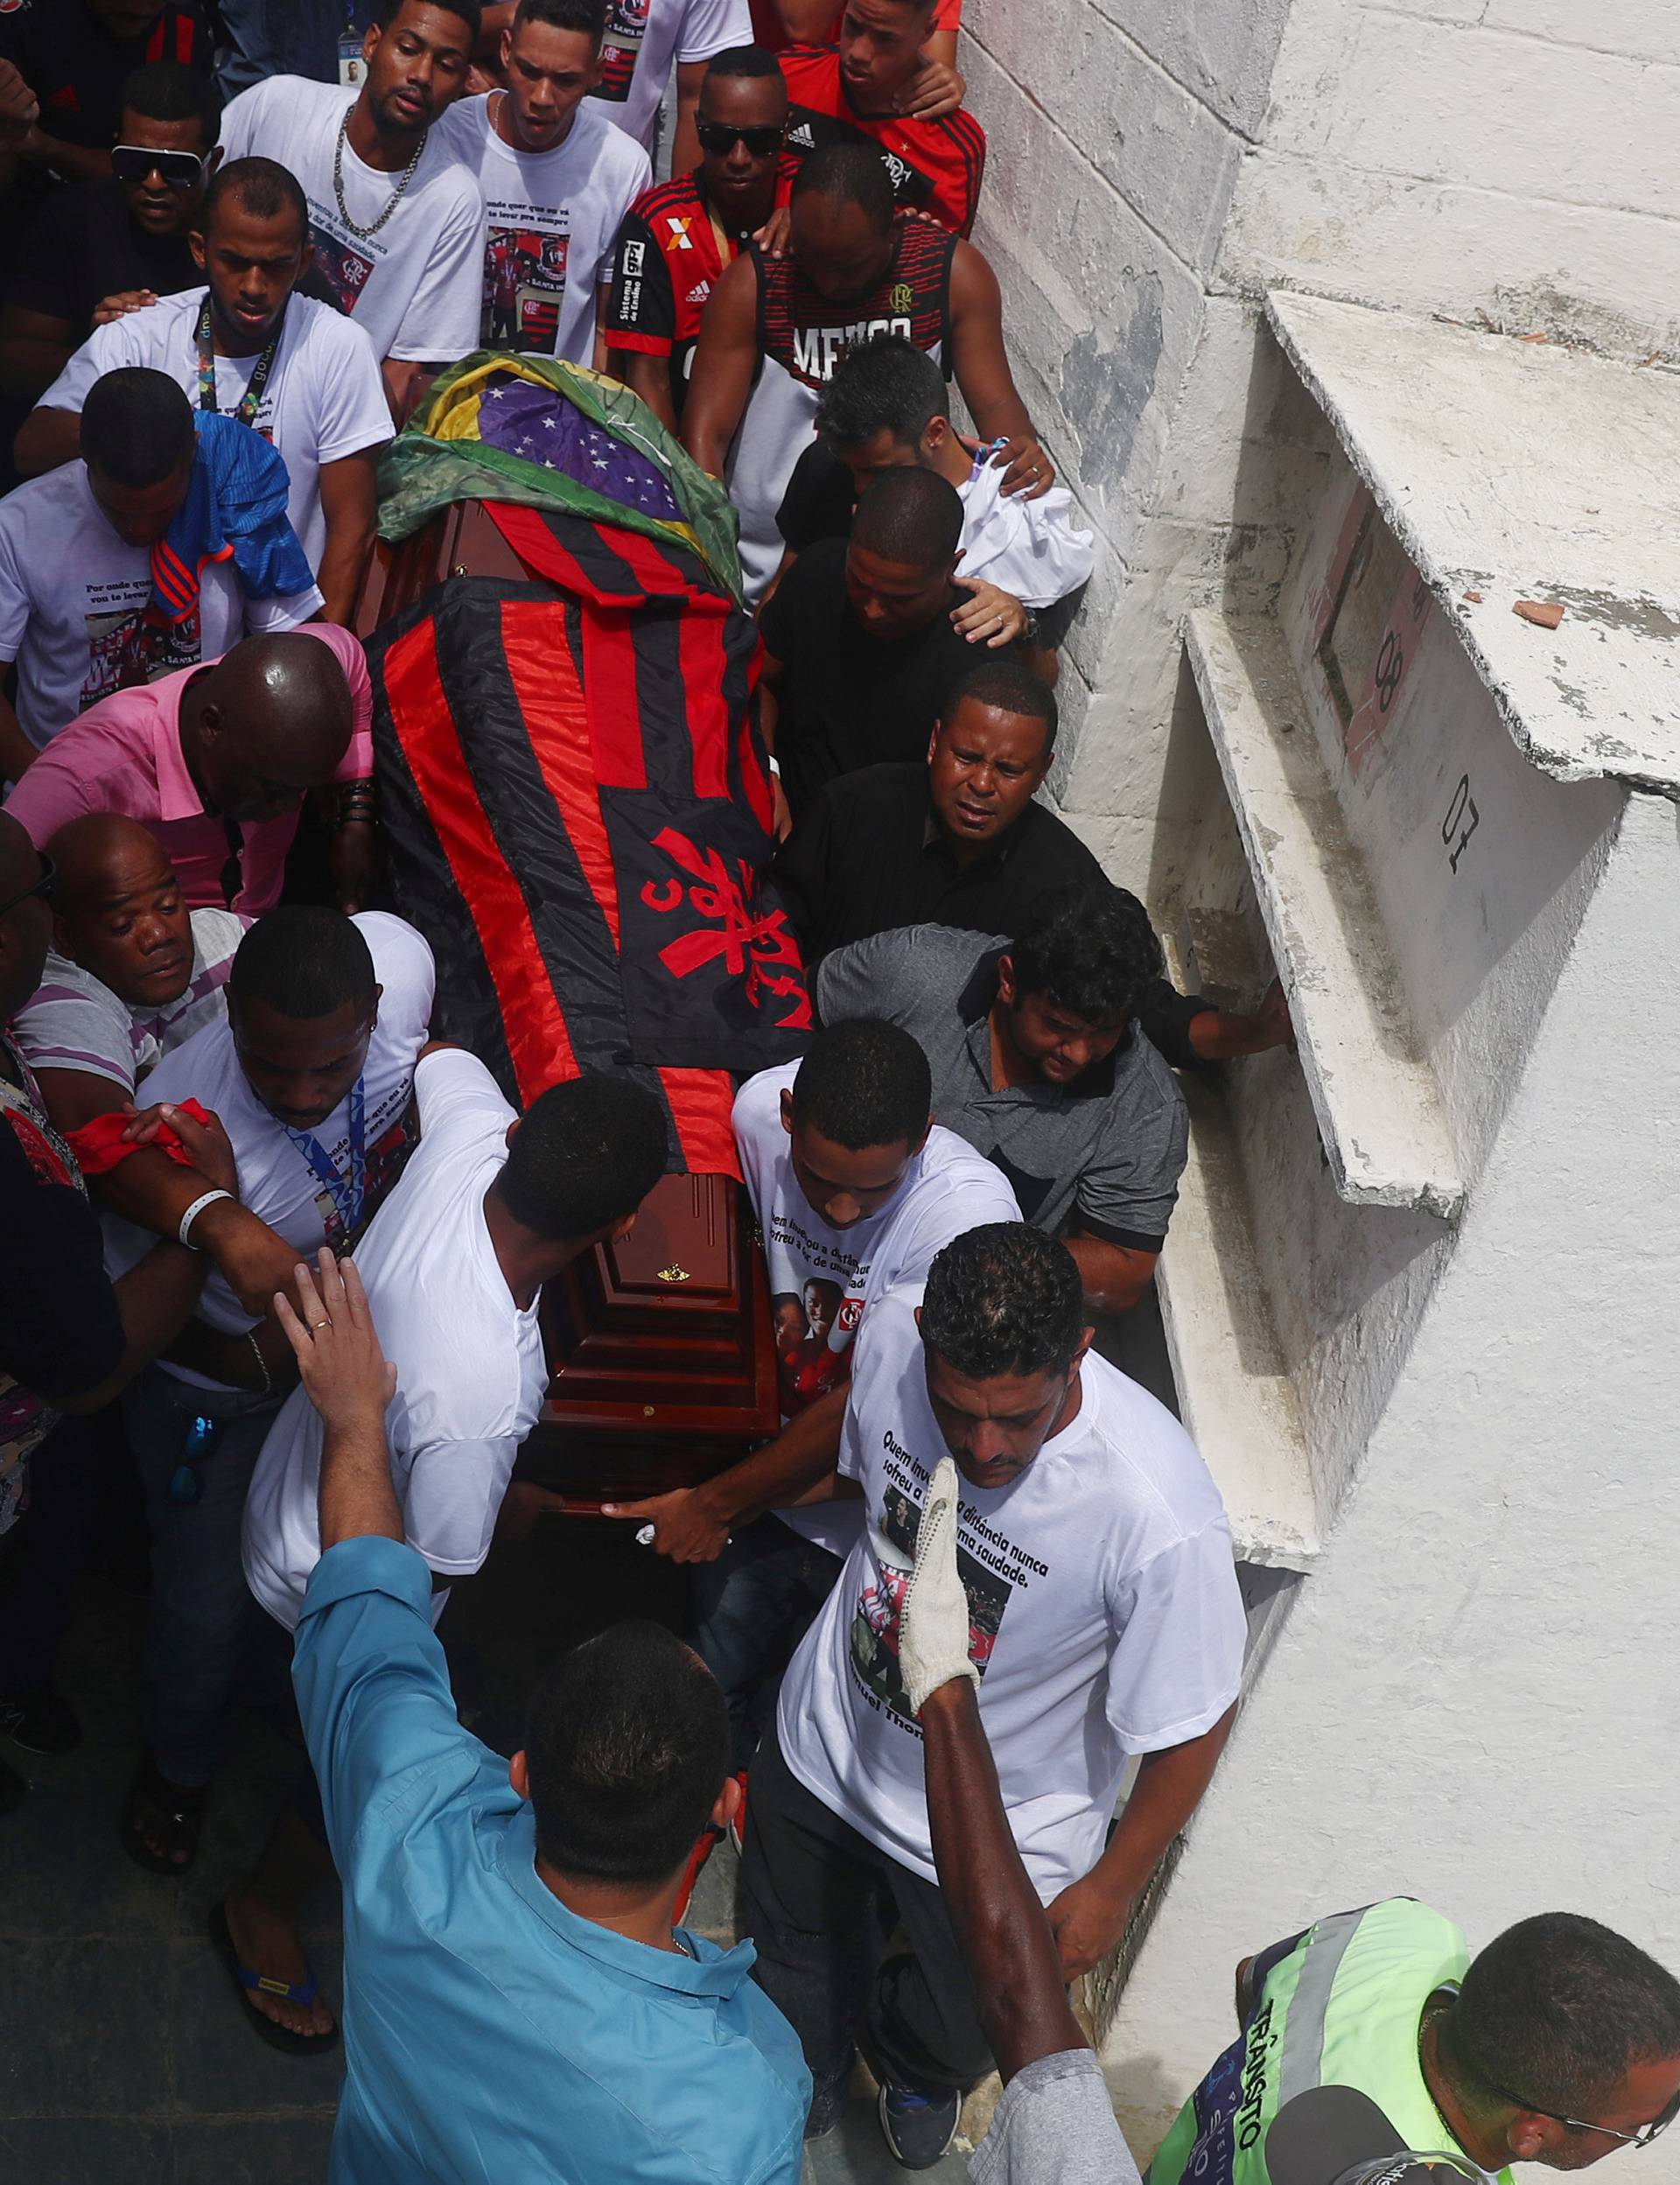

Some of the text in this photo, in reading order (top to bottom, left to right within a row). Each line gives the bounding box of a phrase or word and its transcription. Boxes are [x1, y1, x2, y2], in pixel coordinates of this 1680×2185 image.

[788, 133, 815, 149] adidas
[620, 280, 633, 320] Sistema
[630, 281, 641, 310] Ensino
[90, 595, 108, 604] vou
[106, 581, 130, 591] onde
[770, 1230, 794, 1245] ofreu
[813, 1257, 827, 1268] de
[883, 1430, 911, 1467] Quem
[962, 1506, 1010, 1551] distância
[1010, 1545, 1049, 1577] nunca
[883, 1459, 914, 1495] sofreu
[914, 1488, 923, 1501] a
[976, 1544, 1029, 1588] saudade.
